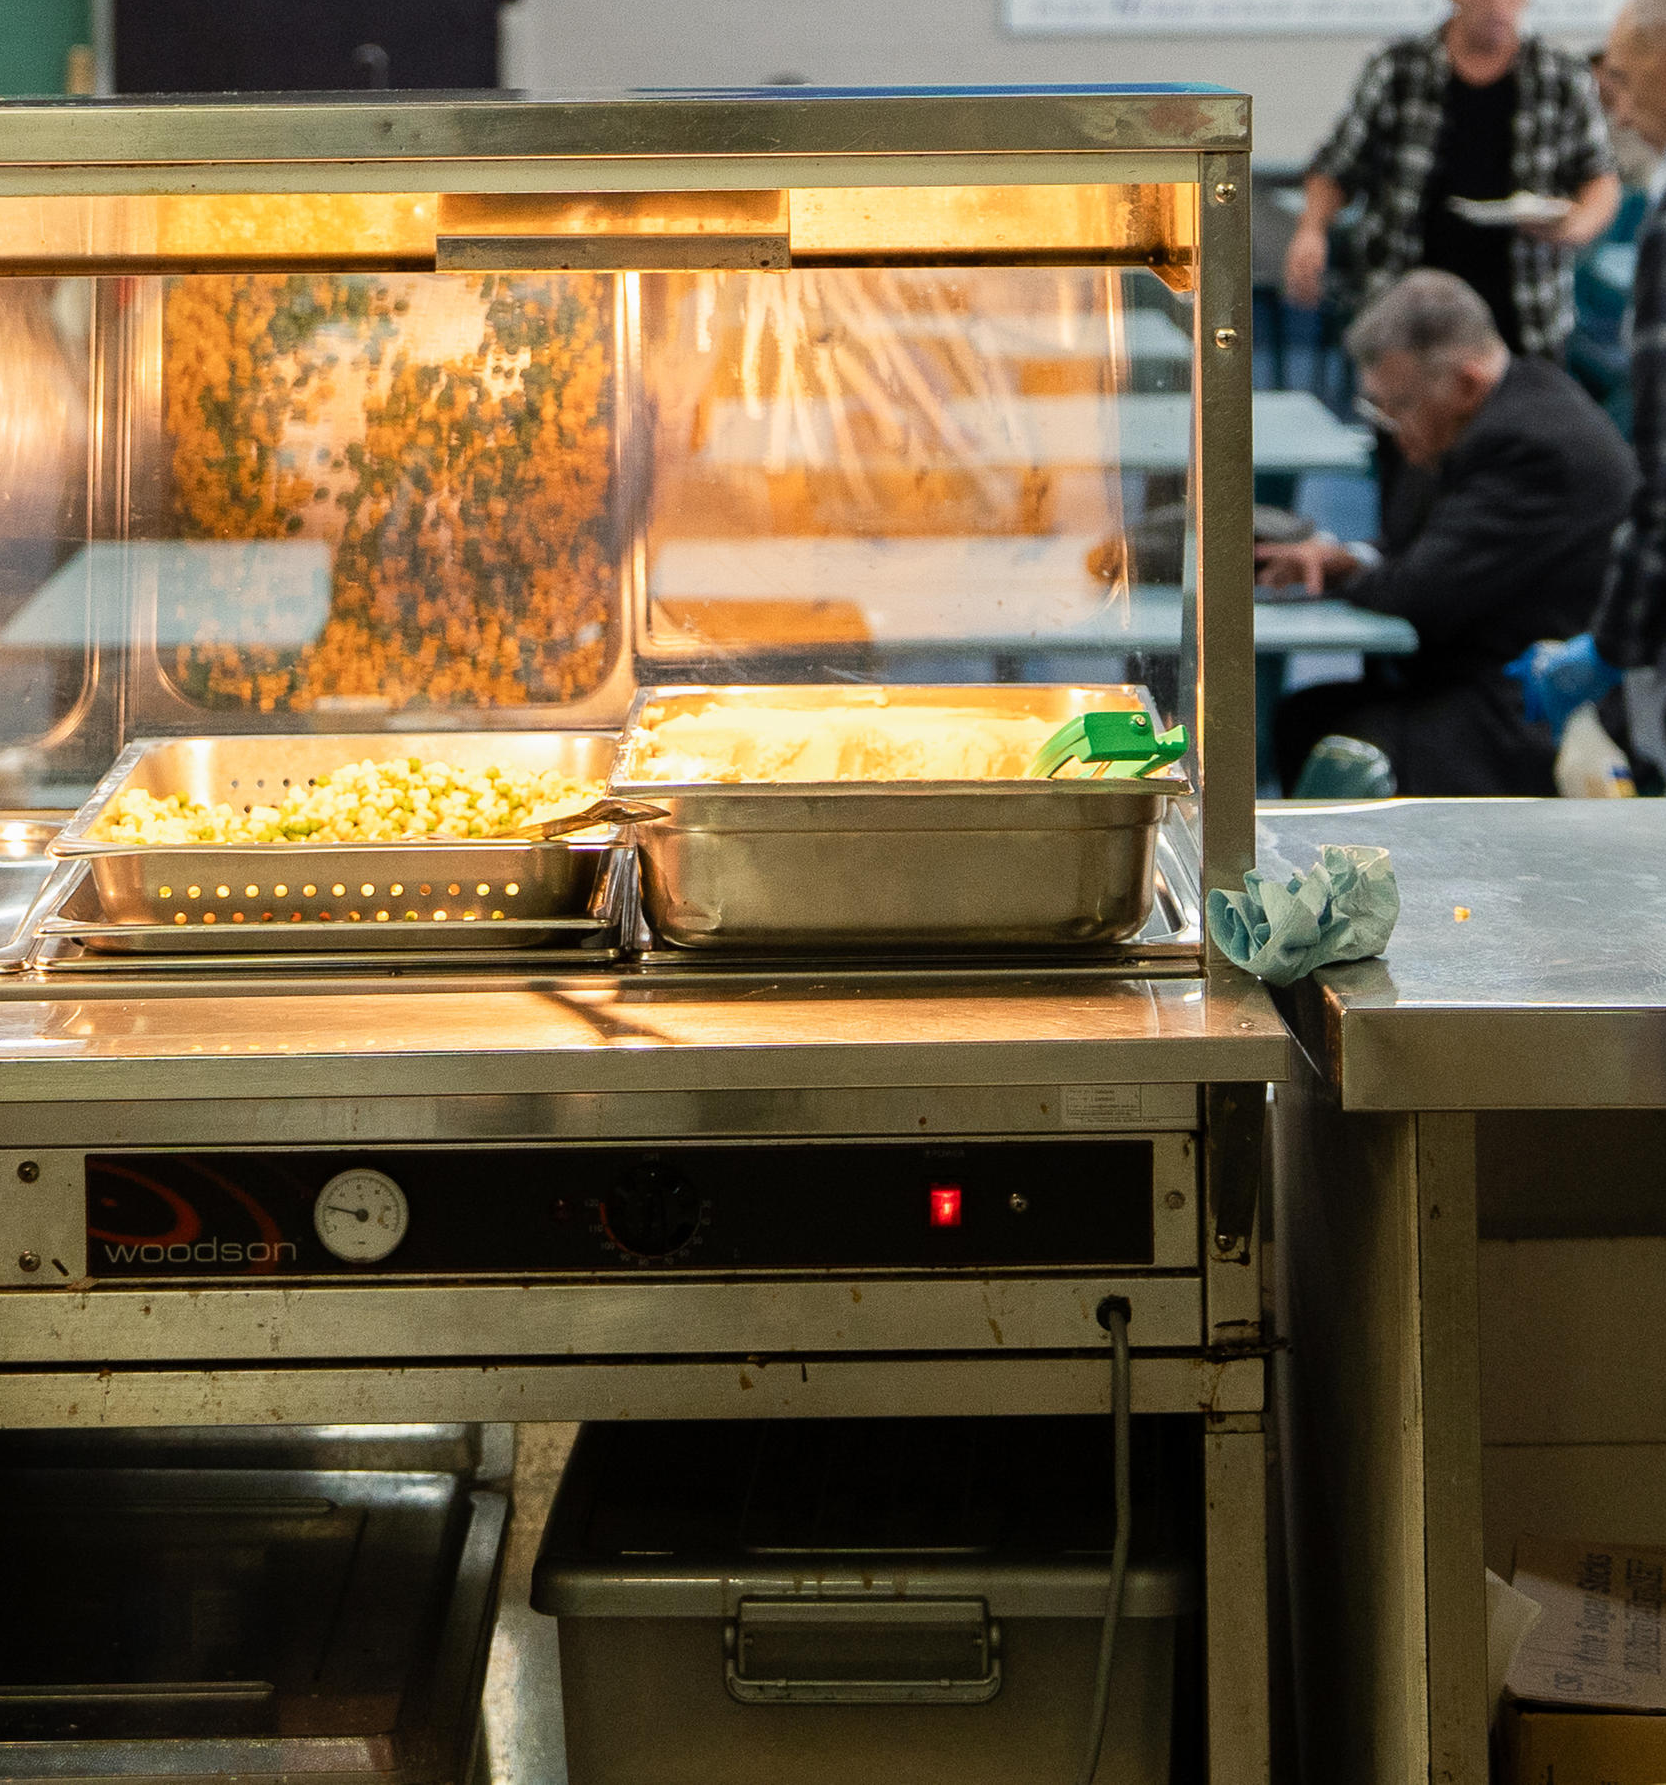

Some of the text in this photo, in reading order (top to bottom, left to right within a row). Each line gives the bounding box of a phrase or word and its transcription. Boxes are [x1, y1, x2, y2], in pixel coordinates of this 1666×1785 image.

[104, 1236, 298, 1263] woodson
[1576, 1553, 1613, 1594] Sticks
[1575, 1595, 1616, 1633] Sugar
